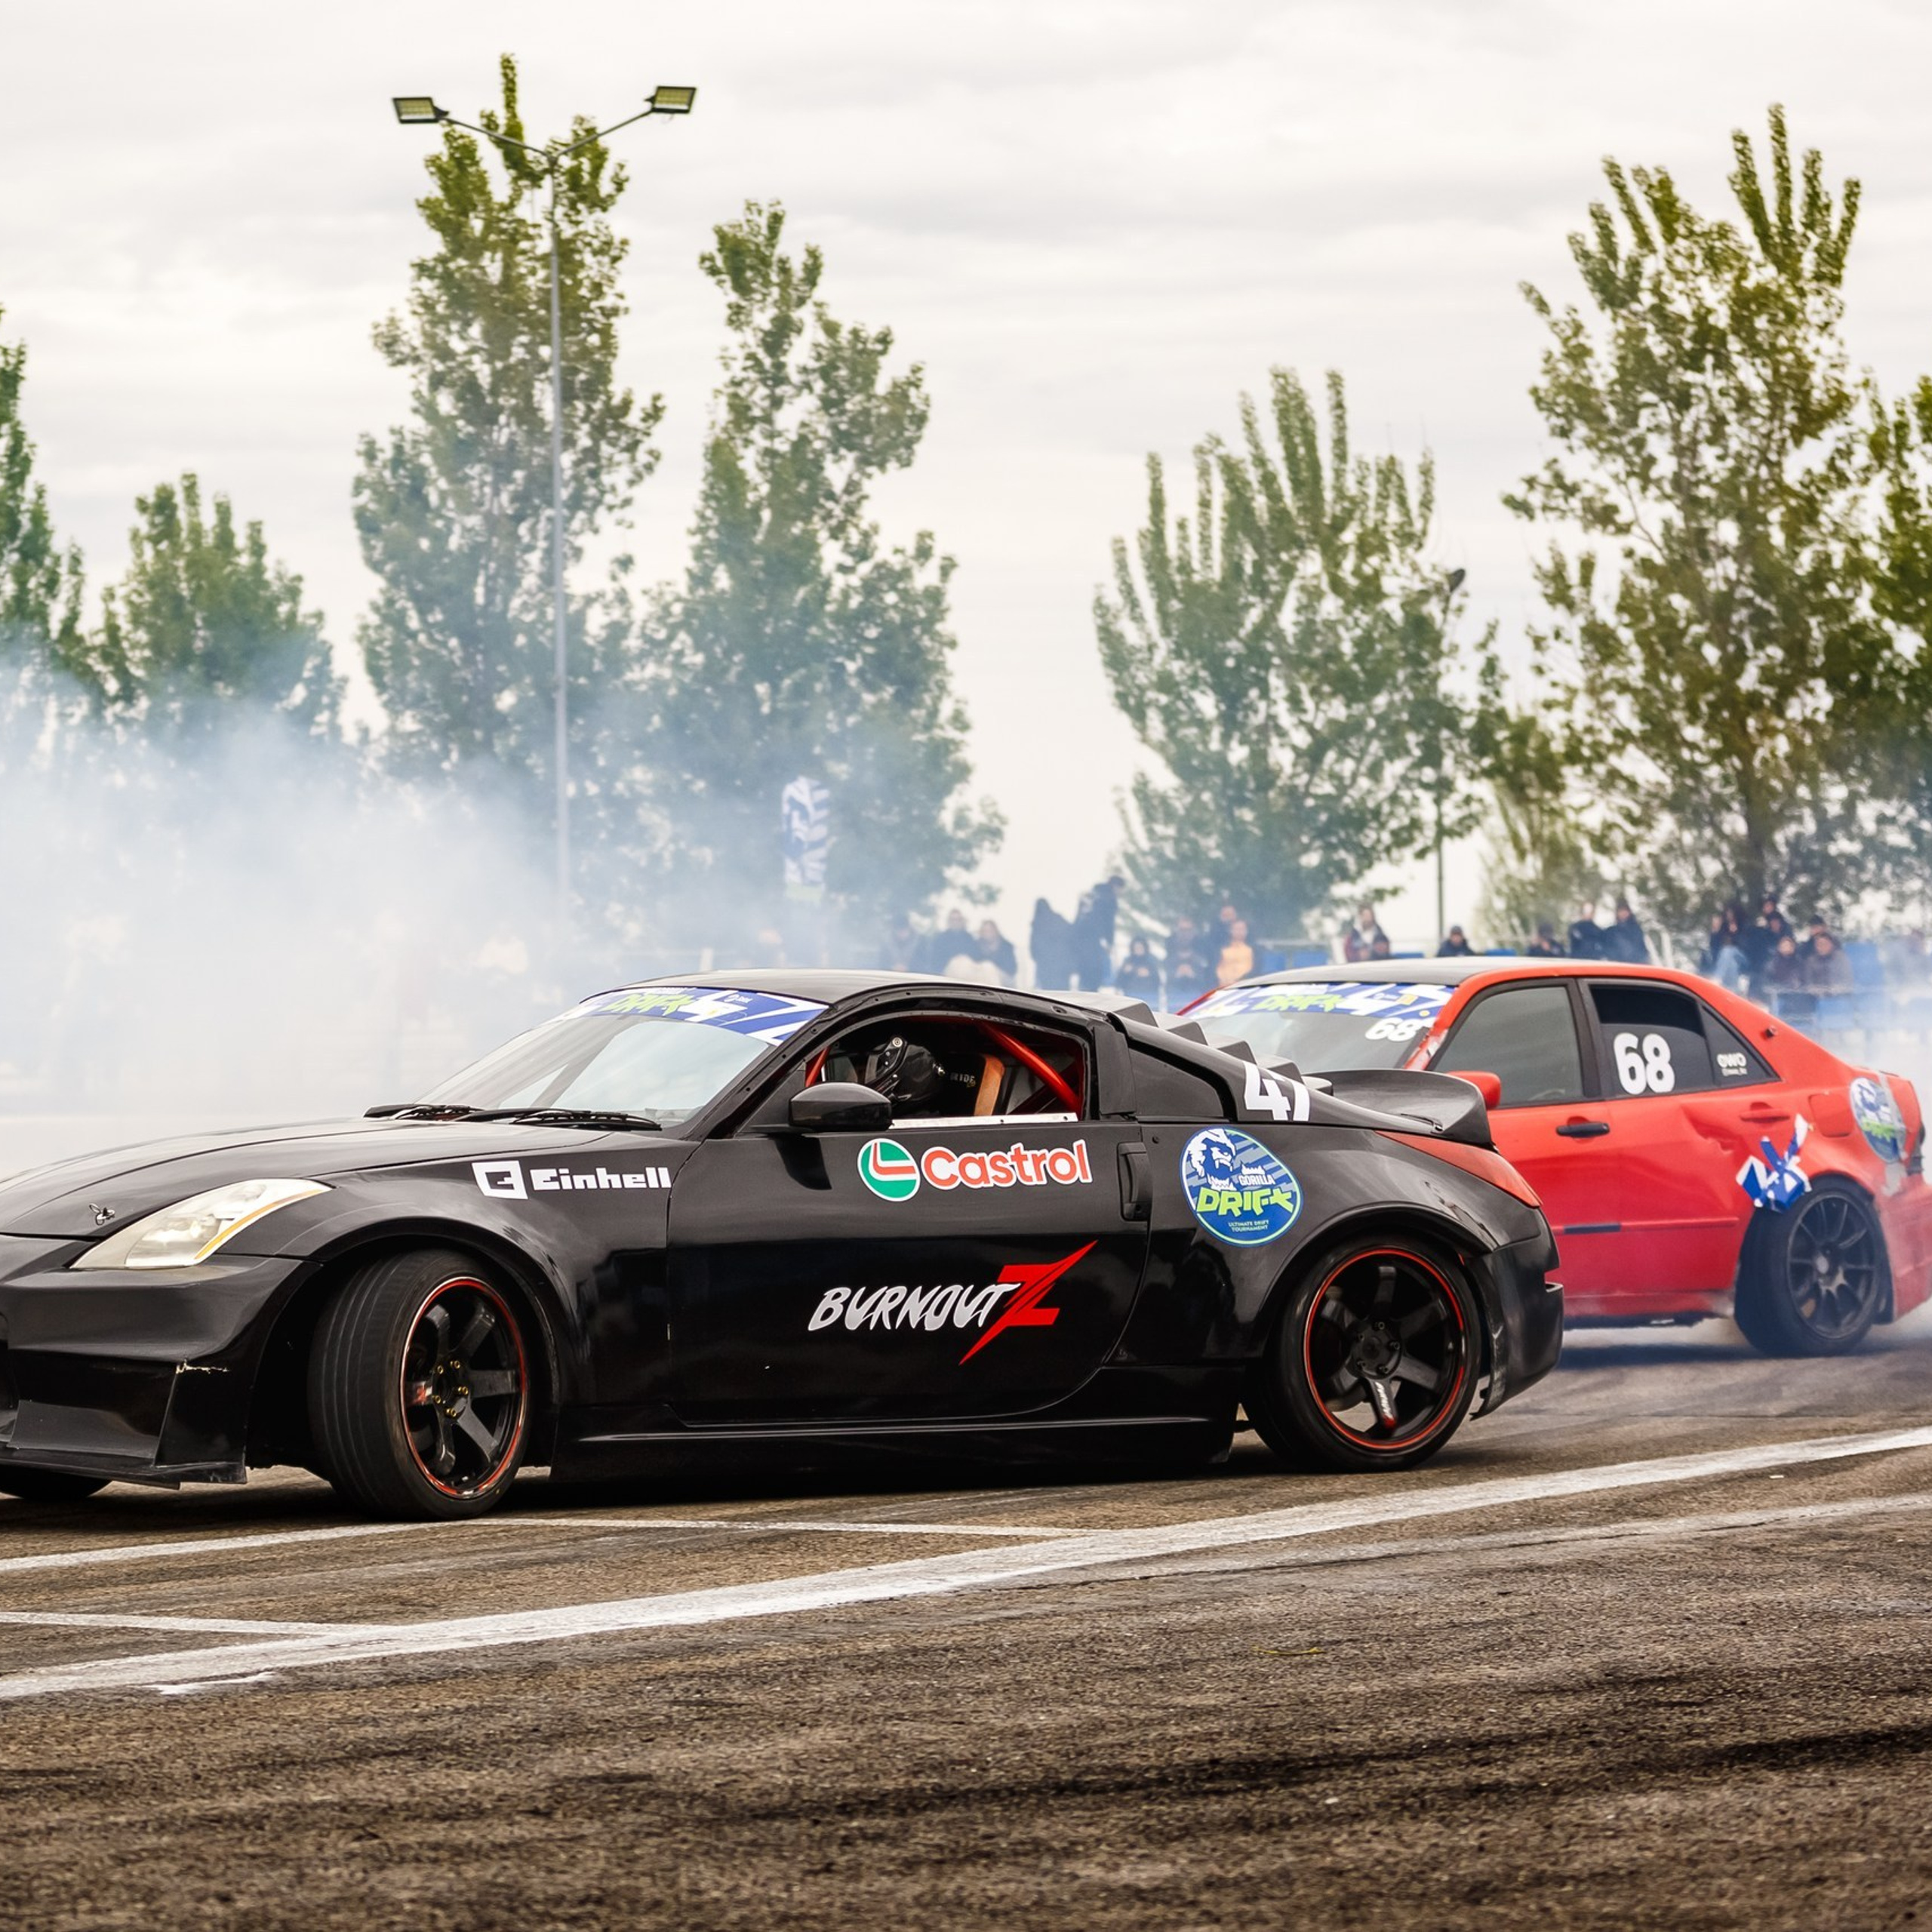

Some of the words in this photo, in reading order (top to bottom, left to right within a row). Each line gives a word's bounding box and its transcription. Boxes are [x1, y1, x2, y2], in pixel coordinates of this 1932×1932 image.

[1364, 1017, 1423, 1041] 68
[1614, 1032, 1675, 1094] 68
[1242, 1060, 1310, 1121] 47
[530, 1167, 672, 1191] Einhell
[922, 1140, 1092, 1189] Castrol
[1238, 1174, 1276, 1186] GORILLA
[1196, 1187, 1294, 1217] DRIFT
